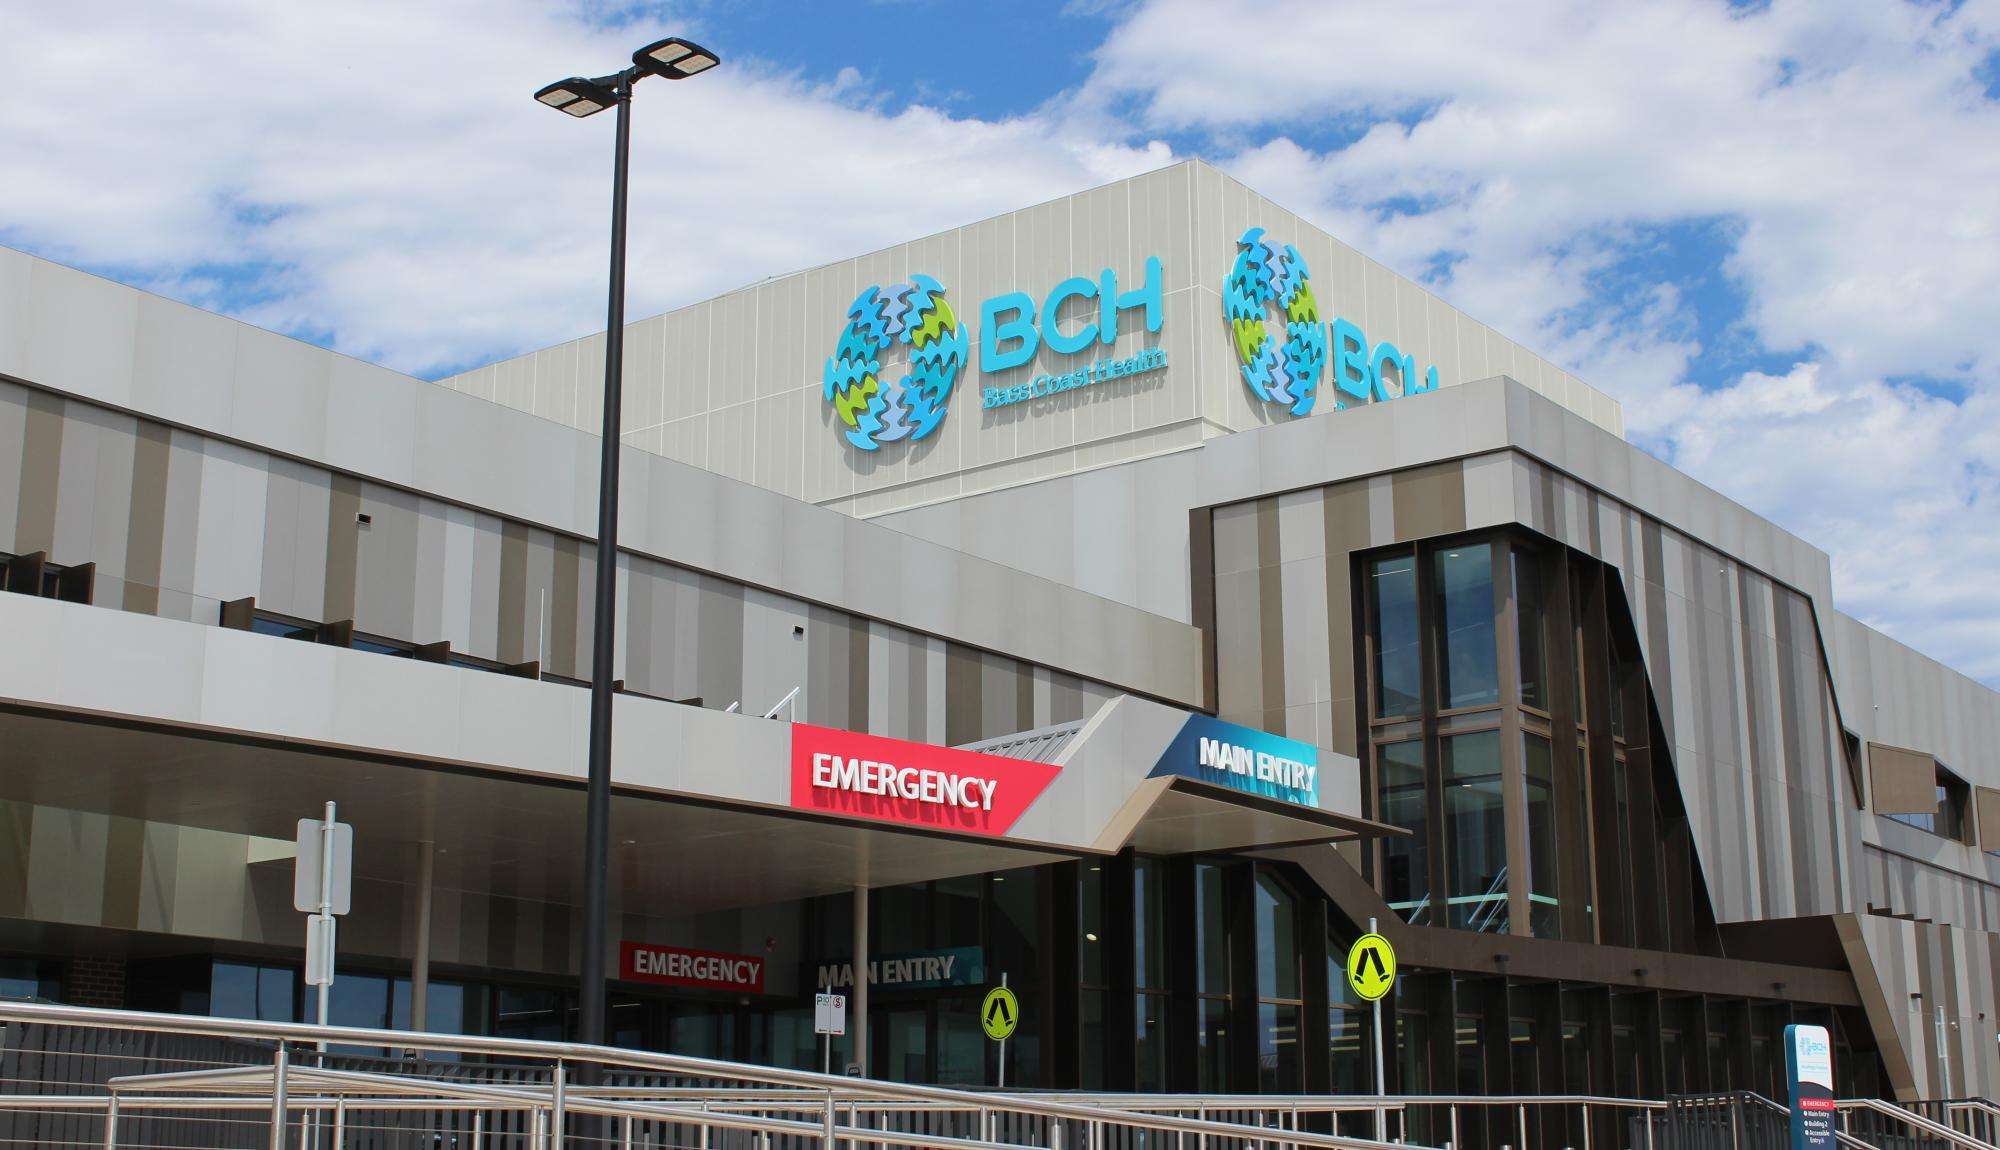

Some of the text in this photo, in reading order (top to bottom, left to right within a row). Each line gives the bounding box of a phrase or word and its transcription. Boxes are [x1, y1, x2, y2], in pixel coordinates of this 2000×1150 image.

[981, 255, 1163, 373] BCH
[983, 348, 1168, 409] Bass Coast Health
[812, 752, 997, 811] EMERGENCY
[1200, 737, 1317, 792] MAIN ENTRY
[634, 949, 760, 985] EMERGENCY
[818, 955, 955, 989] MAN ENTRY
